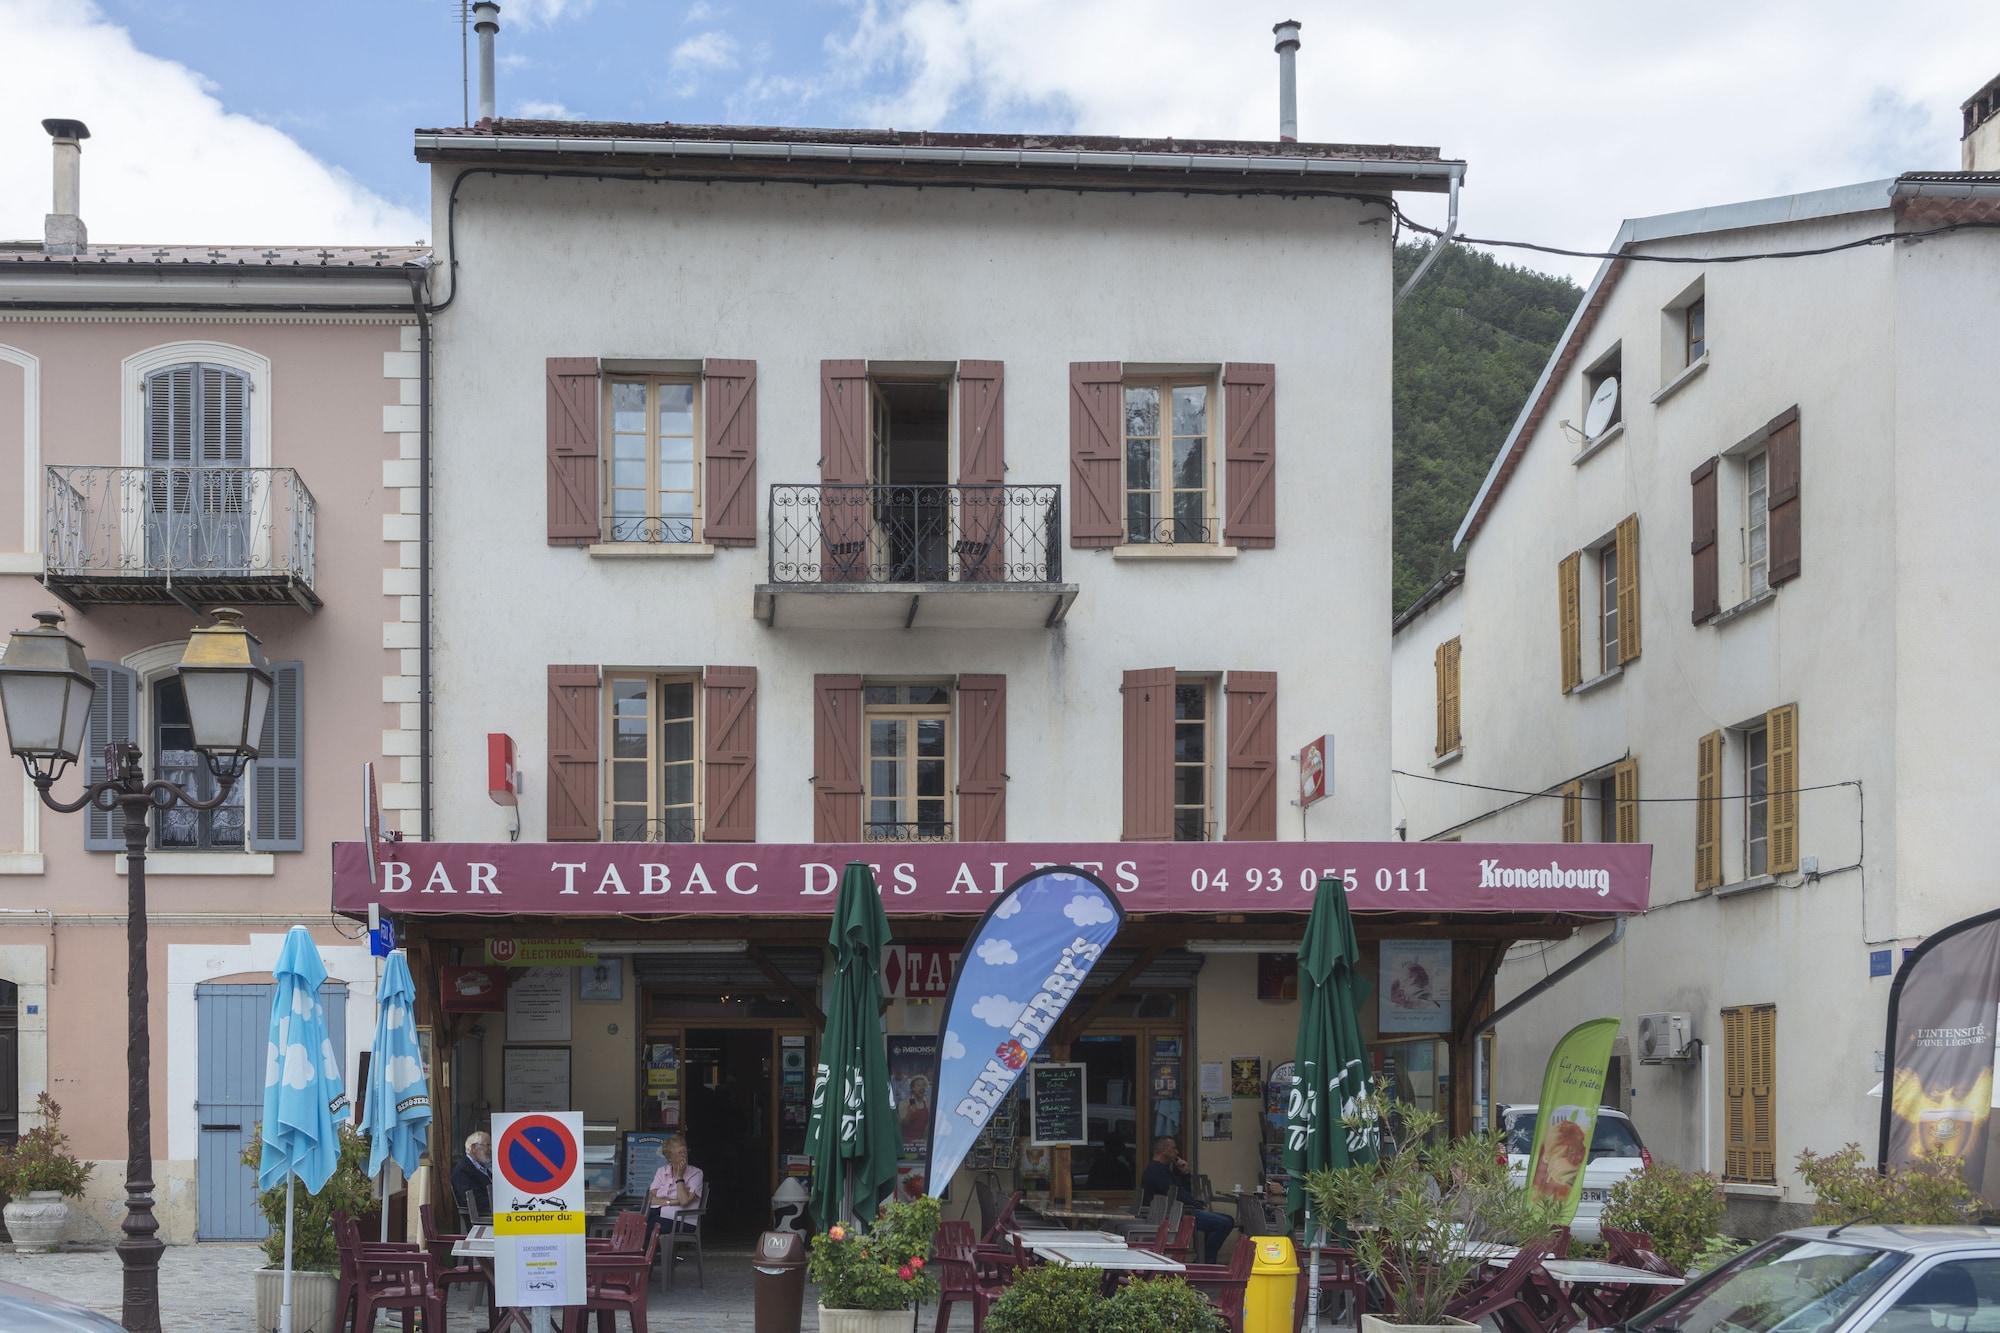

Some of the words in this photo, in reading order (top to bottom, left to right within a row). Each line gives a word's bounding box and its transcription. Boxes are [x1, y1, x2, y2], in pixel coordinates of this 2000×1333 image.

[380, 861, 503, 895] BAR
[550, 861, 760, 896] TABAC
[1191, 868, 1230, 893] 04
[1245, 868, 1284, 893] 93
[1375, 867, 1429, 892] 011
[1478, 859, 1610, 896] Kronenbourg
[493, 940, 513, 955] ICI
[955, 1059, 1017, 1128] BEN
[1009, 936, 1102, 1049] JERRY'S
[1917, 1022, 1985, 1039] L'INTENSITÉ
[506, 1213, 512, 1222] à
[515, 1213, 554, 1223] compter
[557, 1212, 573, 1221] du:
